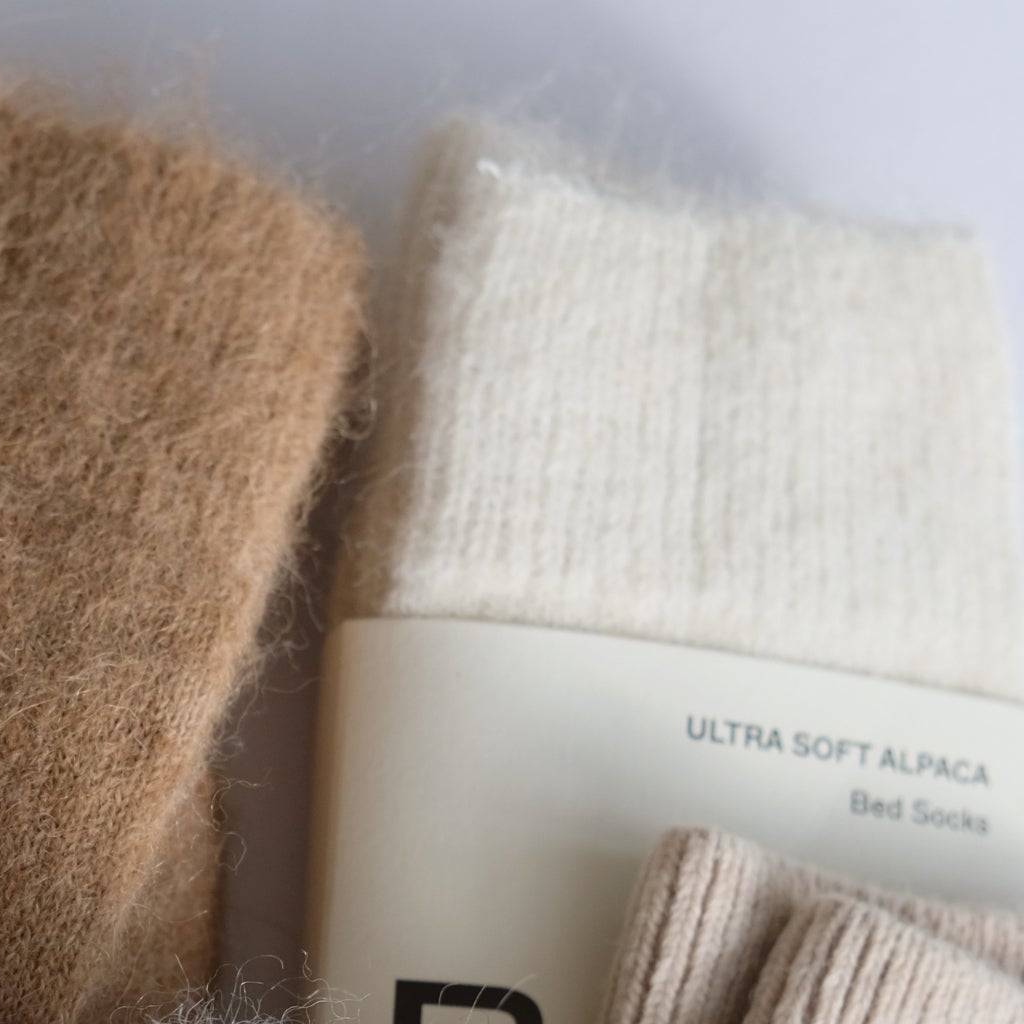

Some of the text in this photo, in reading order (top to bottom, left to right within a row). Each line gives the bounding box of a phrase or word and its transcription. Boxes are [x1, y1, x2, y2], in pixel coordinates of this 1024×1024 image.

[686, 715, 990, 786] ULTRA SOFT ALPACA
[849, 788, 990, 836] Bed Socks
